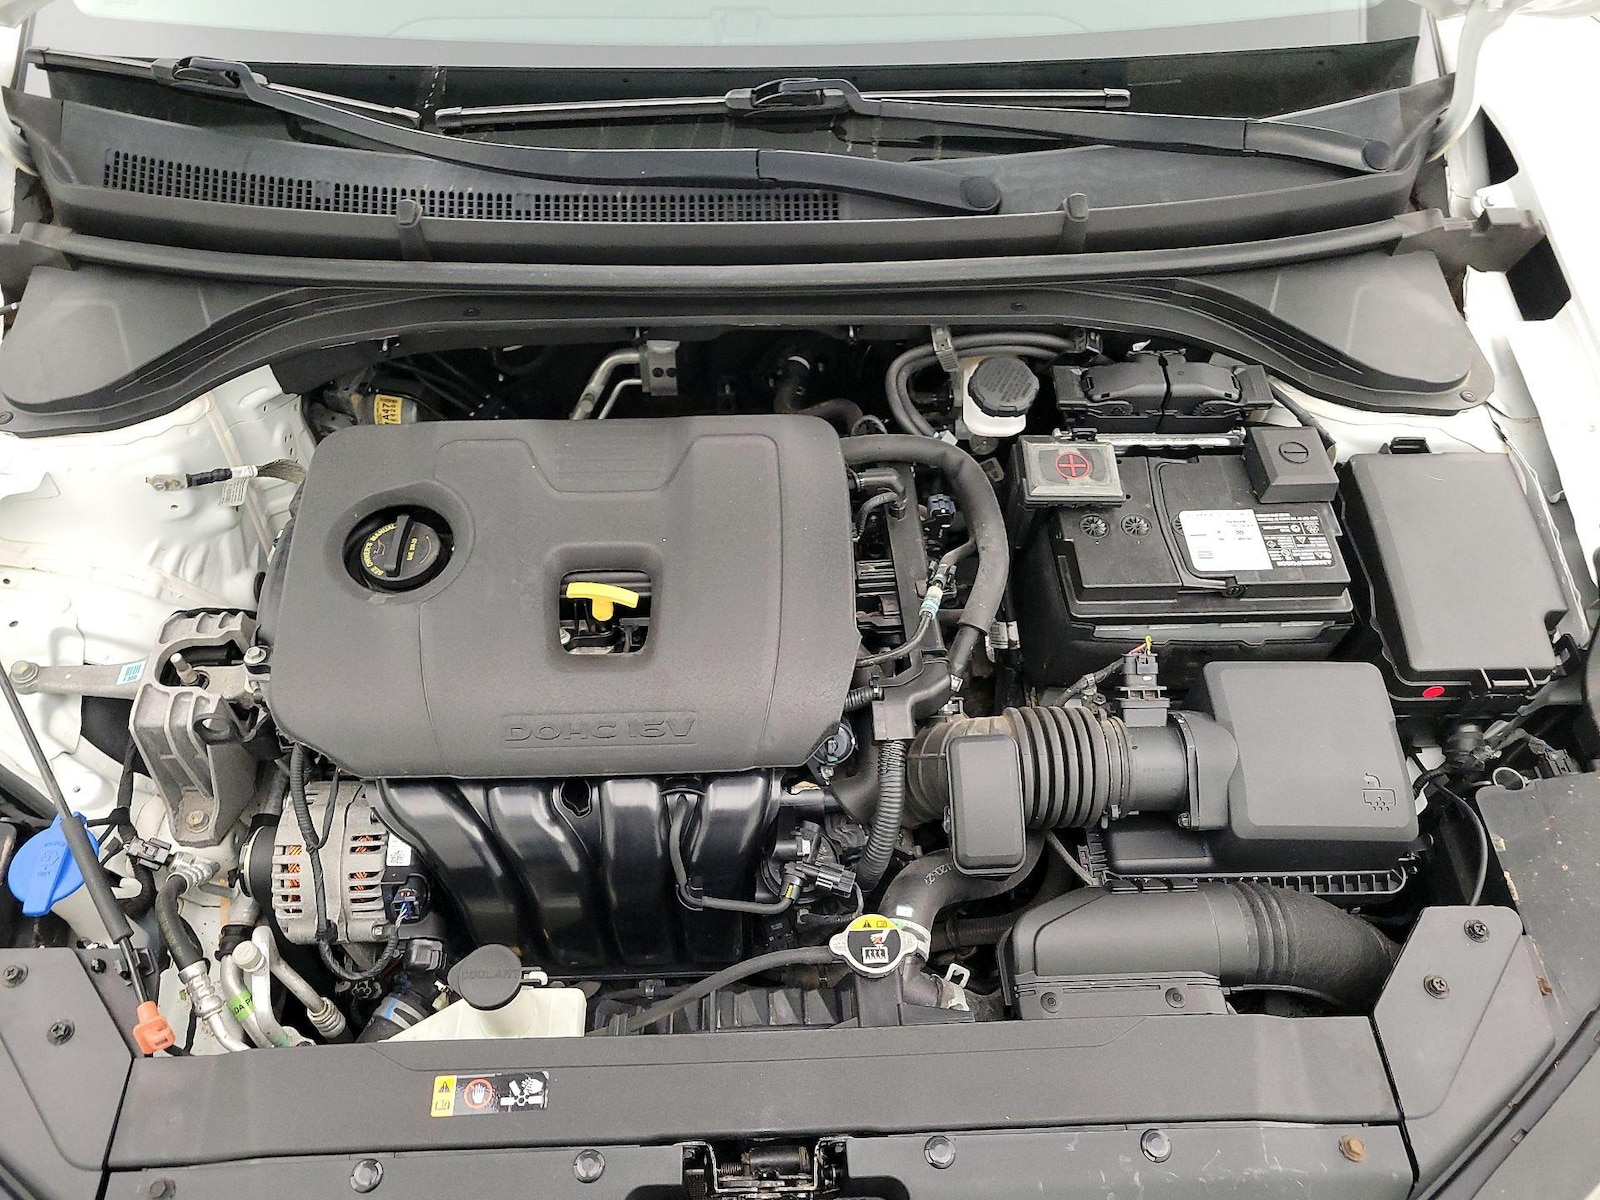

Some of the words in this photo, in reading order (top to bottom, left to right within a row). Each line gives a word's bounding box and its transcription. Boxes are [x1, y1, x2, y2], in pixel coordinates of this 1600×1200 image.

[370, 522, 398, 542] MANUAL
[363, 541, 374, 568] OWNER'S
[370, 565, 385, 577] SEE
[504, 721, 617, 742] DOHC
[627, 718, 696, 739] 16V
[461, 966, 521, 981] COOLANT
